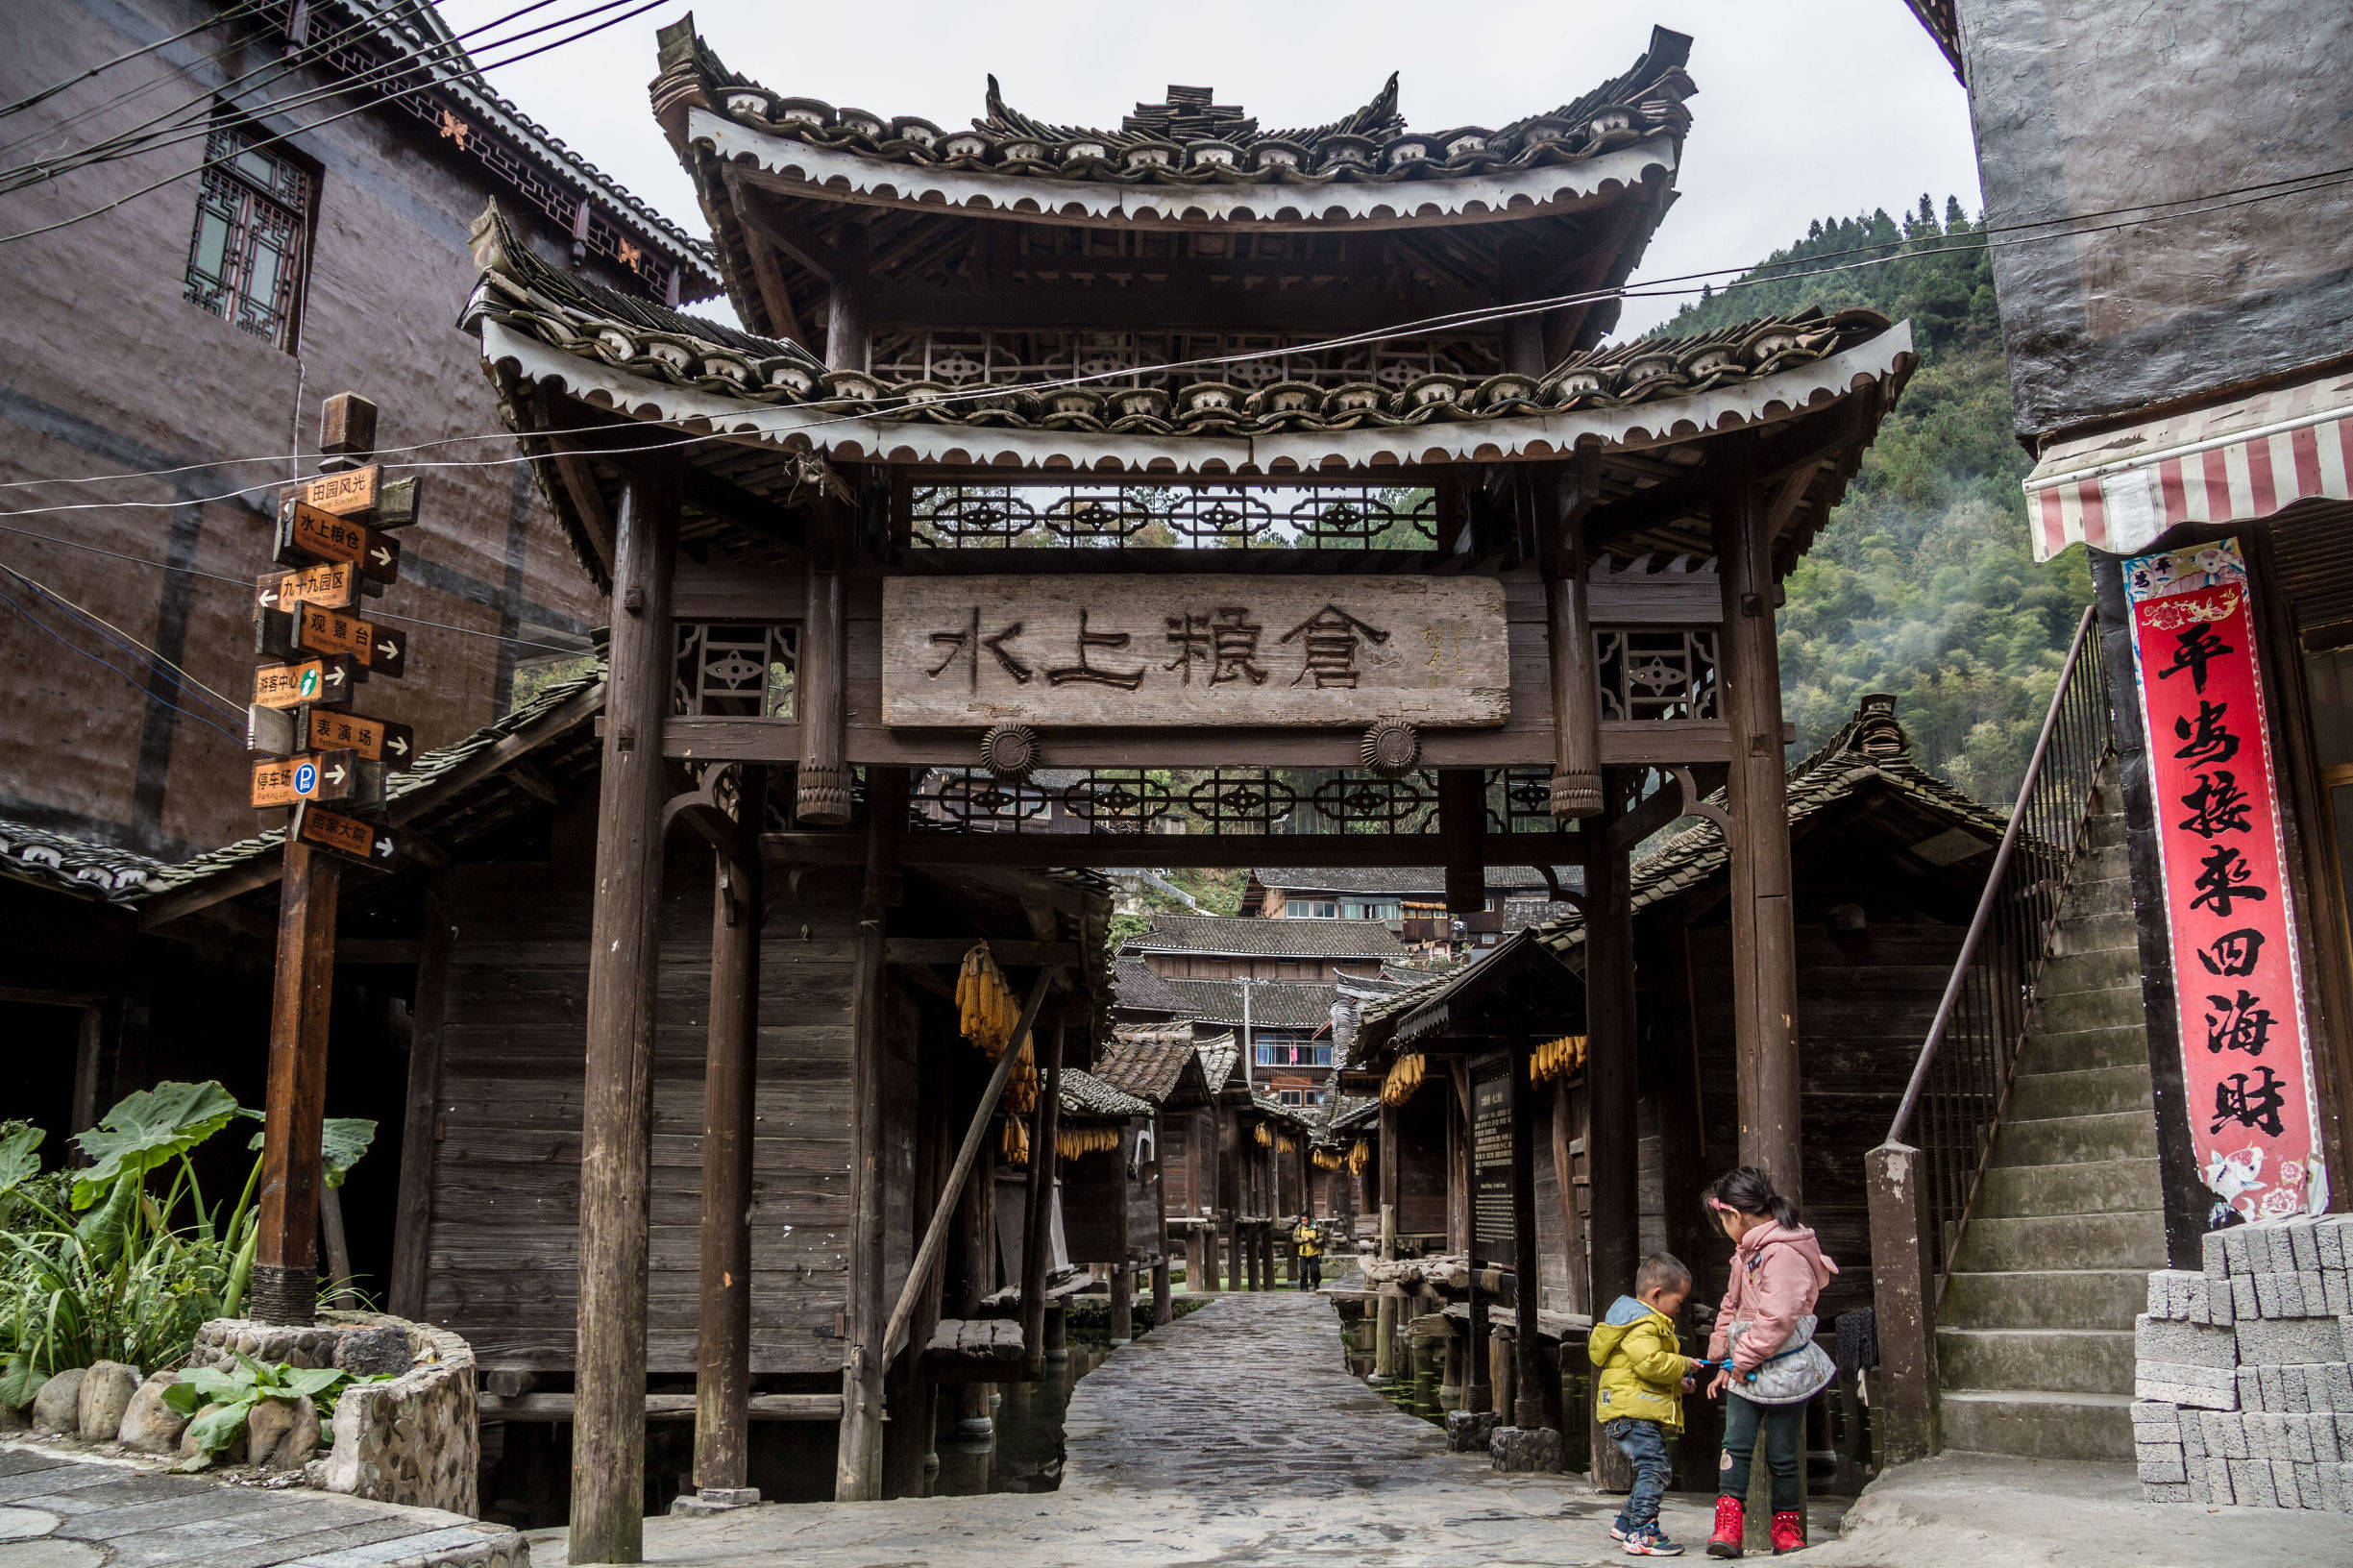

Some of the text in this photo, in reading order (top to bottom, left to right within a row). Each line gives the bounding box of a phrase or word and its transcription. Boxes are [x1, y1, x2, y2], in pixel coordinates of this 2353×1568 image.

[312, 473, 366, 502] 田园风光
[300, 514, 359, 550] 水上粮仓
[282, 572, 344, 597] 九十九园区
[311, 613, 369, 646] 观景台
[258, 672, 298, 693] 游客中心
[317, 719, 371, 747] 表演场
[257, 769, 291, 791] 停车场
